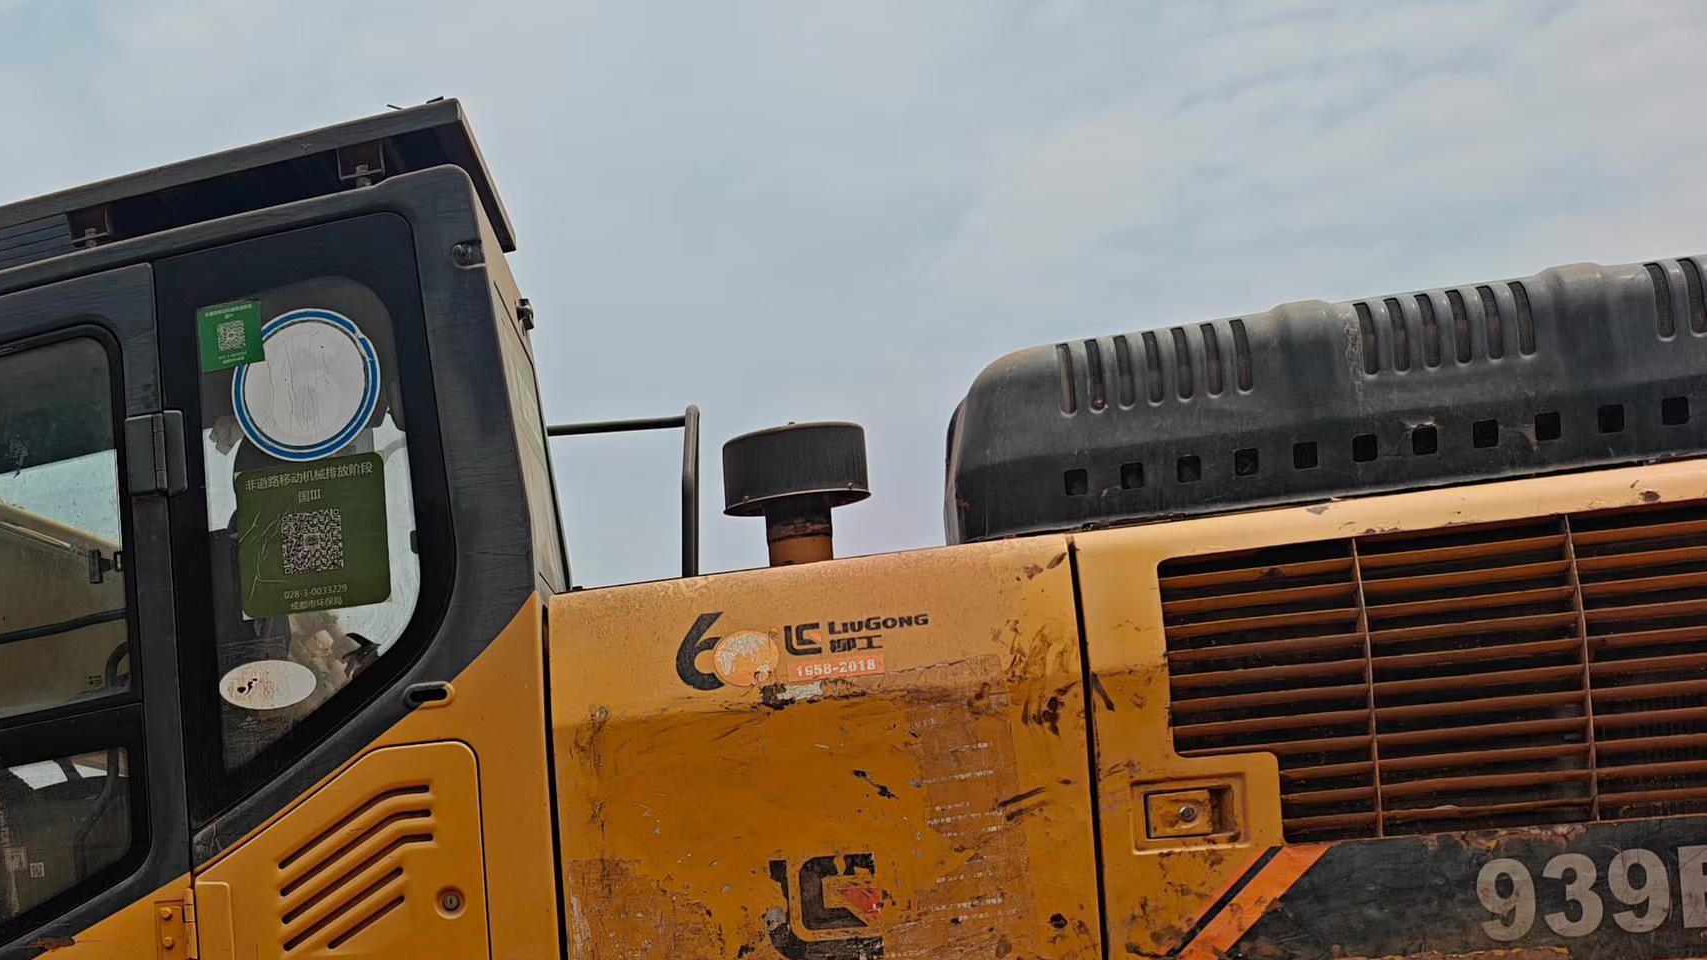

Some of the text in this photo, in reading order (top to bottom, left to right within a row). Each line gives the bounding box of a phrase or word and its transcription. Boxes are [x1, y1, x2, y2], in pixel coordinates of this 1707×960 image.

[245, 460, 373, 492] 非道路移动机械排放阶段
[829, 634, 883, 653] 柳工
[796, 658, 876, 677] 1958-2018
